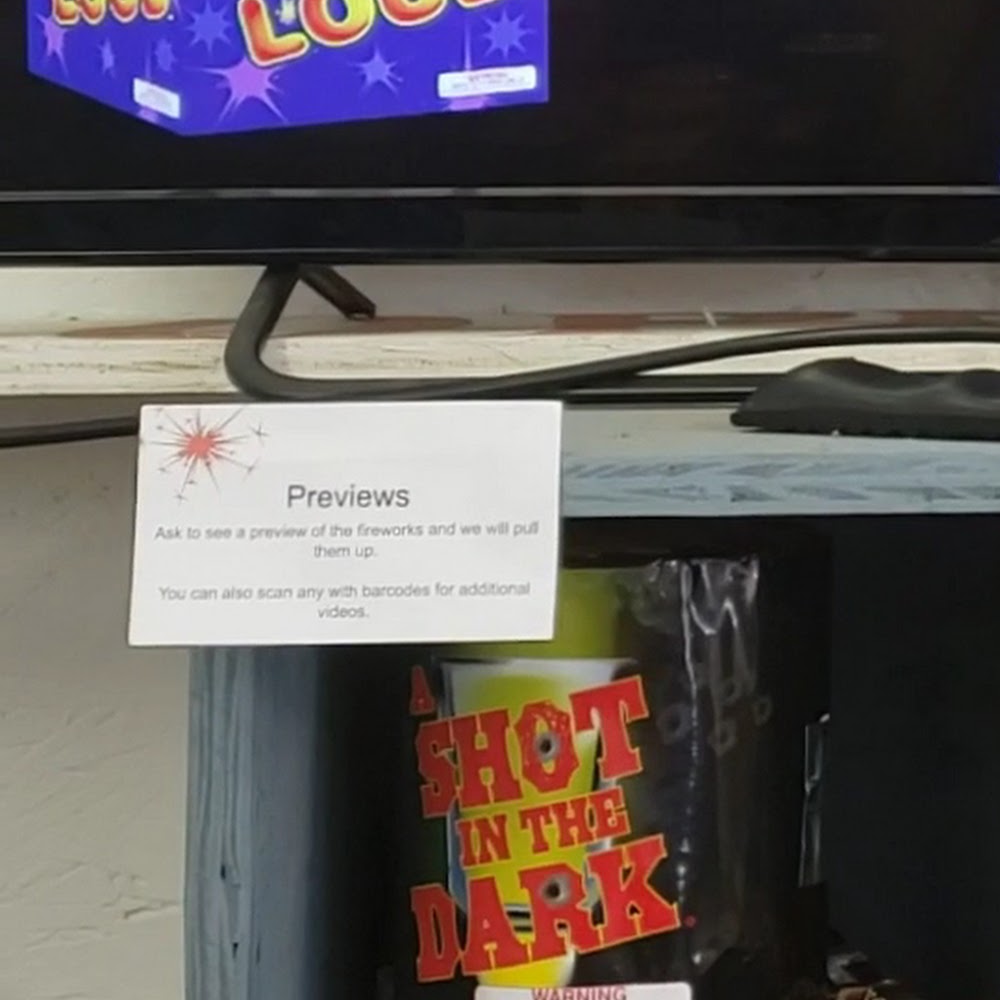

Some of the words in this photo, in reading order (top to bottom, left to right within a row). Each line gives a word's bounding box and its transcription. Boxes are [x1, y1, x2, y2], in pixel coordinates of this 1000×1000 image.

[287, 483, 411, 509] Previews
[155, 526, 182, 540] Ask
[187, 526, 201, 539] to
[205, 528, 232, 540] see
[235, 528, 246, 539] a
[250, 525, 308, 541] preview
[311, 524, 328, 538] of
[329, 523, 353, 537] the
[357, 522, 424, 537] fireworks
[428, 521, 457, 536] and
[460, 523, 482, 536] we
[486, 521, 510, 536] will
[513, 521, 540, 537] pull
[313, 544, 350, 559] them
[354, 546, 379, 559] up.
[158, 586, 186, 601] You
[189, 588, 218, 600] can
[221, 587, 253, 600] also
[257, 587, 293, 599] scan
[297, 587, 324, 602] any
[328, 585, 358, 599] with
[362, 584, 431, 598] barcodes
[434, 582, 455, 597] for
[458, 581, 531, 597] additional
[318, 605, 370, 619] videos.
[410, 665, 436, 715] A
[415, 674, 649, 818] SHOT
[455, 812, 512, 869] IN
[518, 786, 631, 854] THE
[410, 832, 681, 982] DARK
[531, 986, 627, 1000] WARNING
